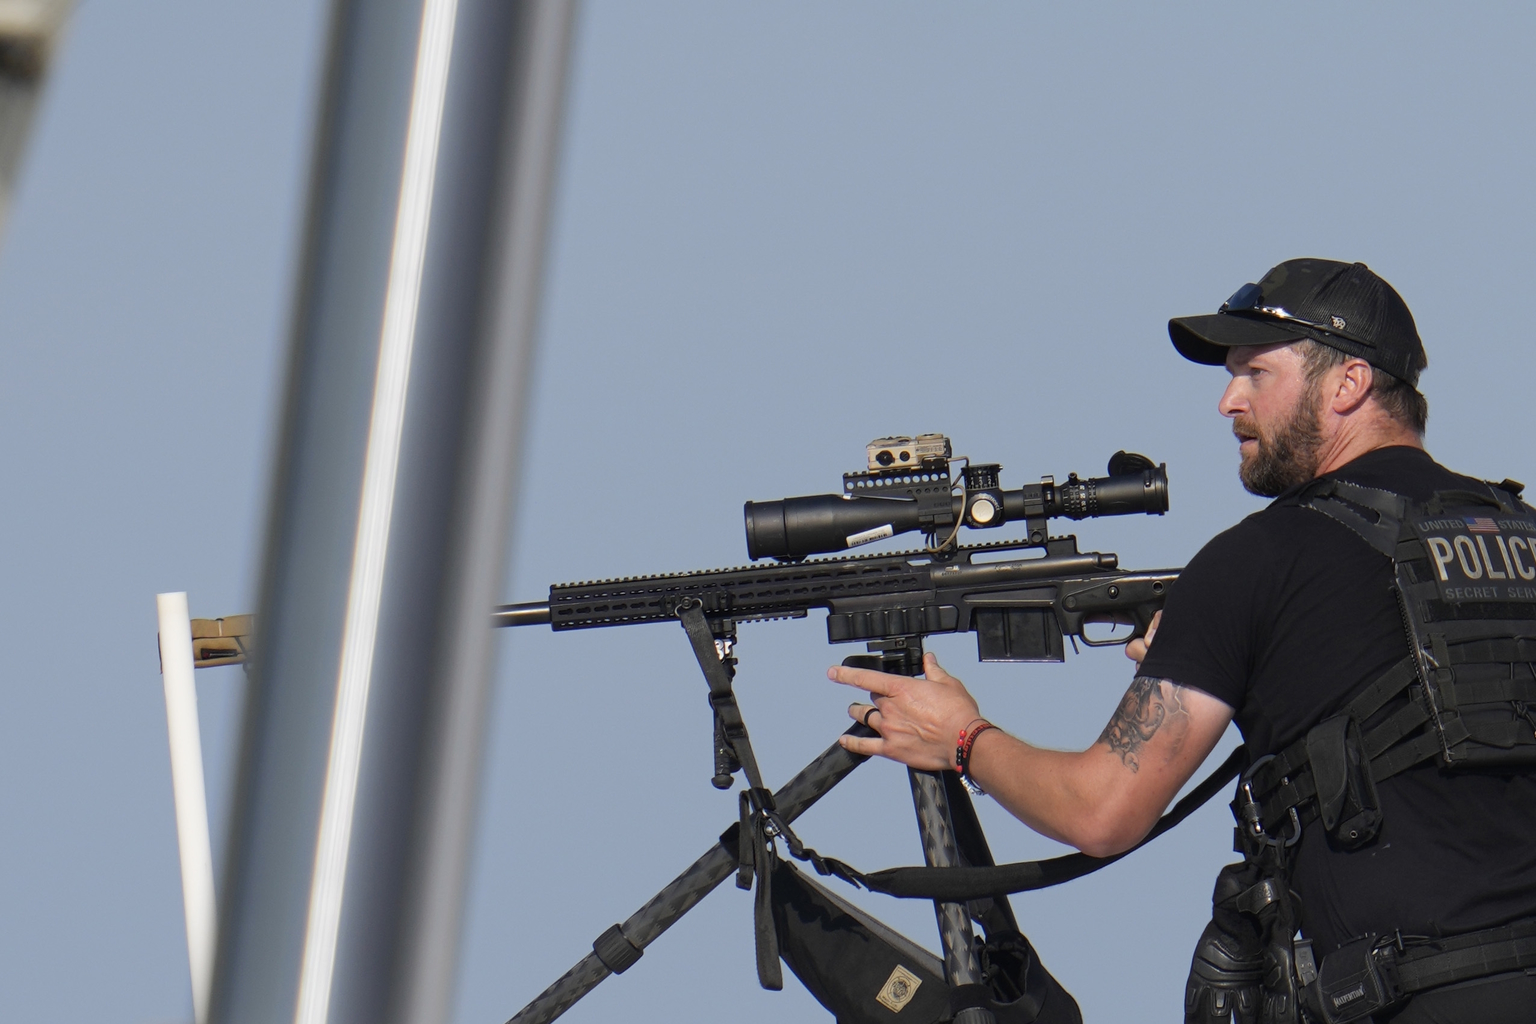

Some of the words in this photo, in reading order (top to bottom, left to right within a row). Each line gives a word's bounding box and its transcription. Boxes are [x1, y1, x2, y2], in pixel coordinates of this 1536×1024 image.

[1419, 519, 1465, 532] UNITED
[1498, 519, 1536, 531] STATES
[1446, 586, 1498, 600] SECRET
